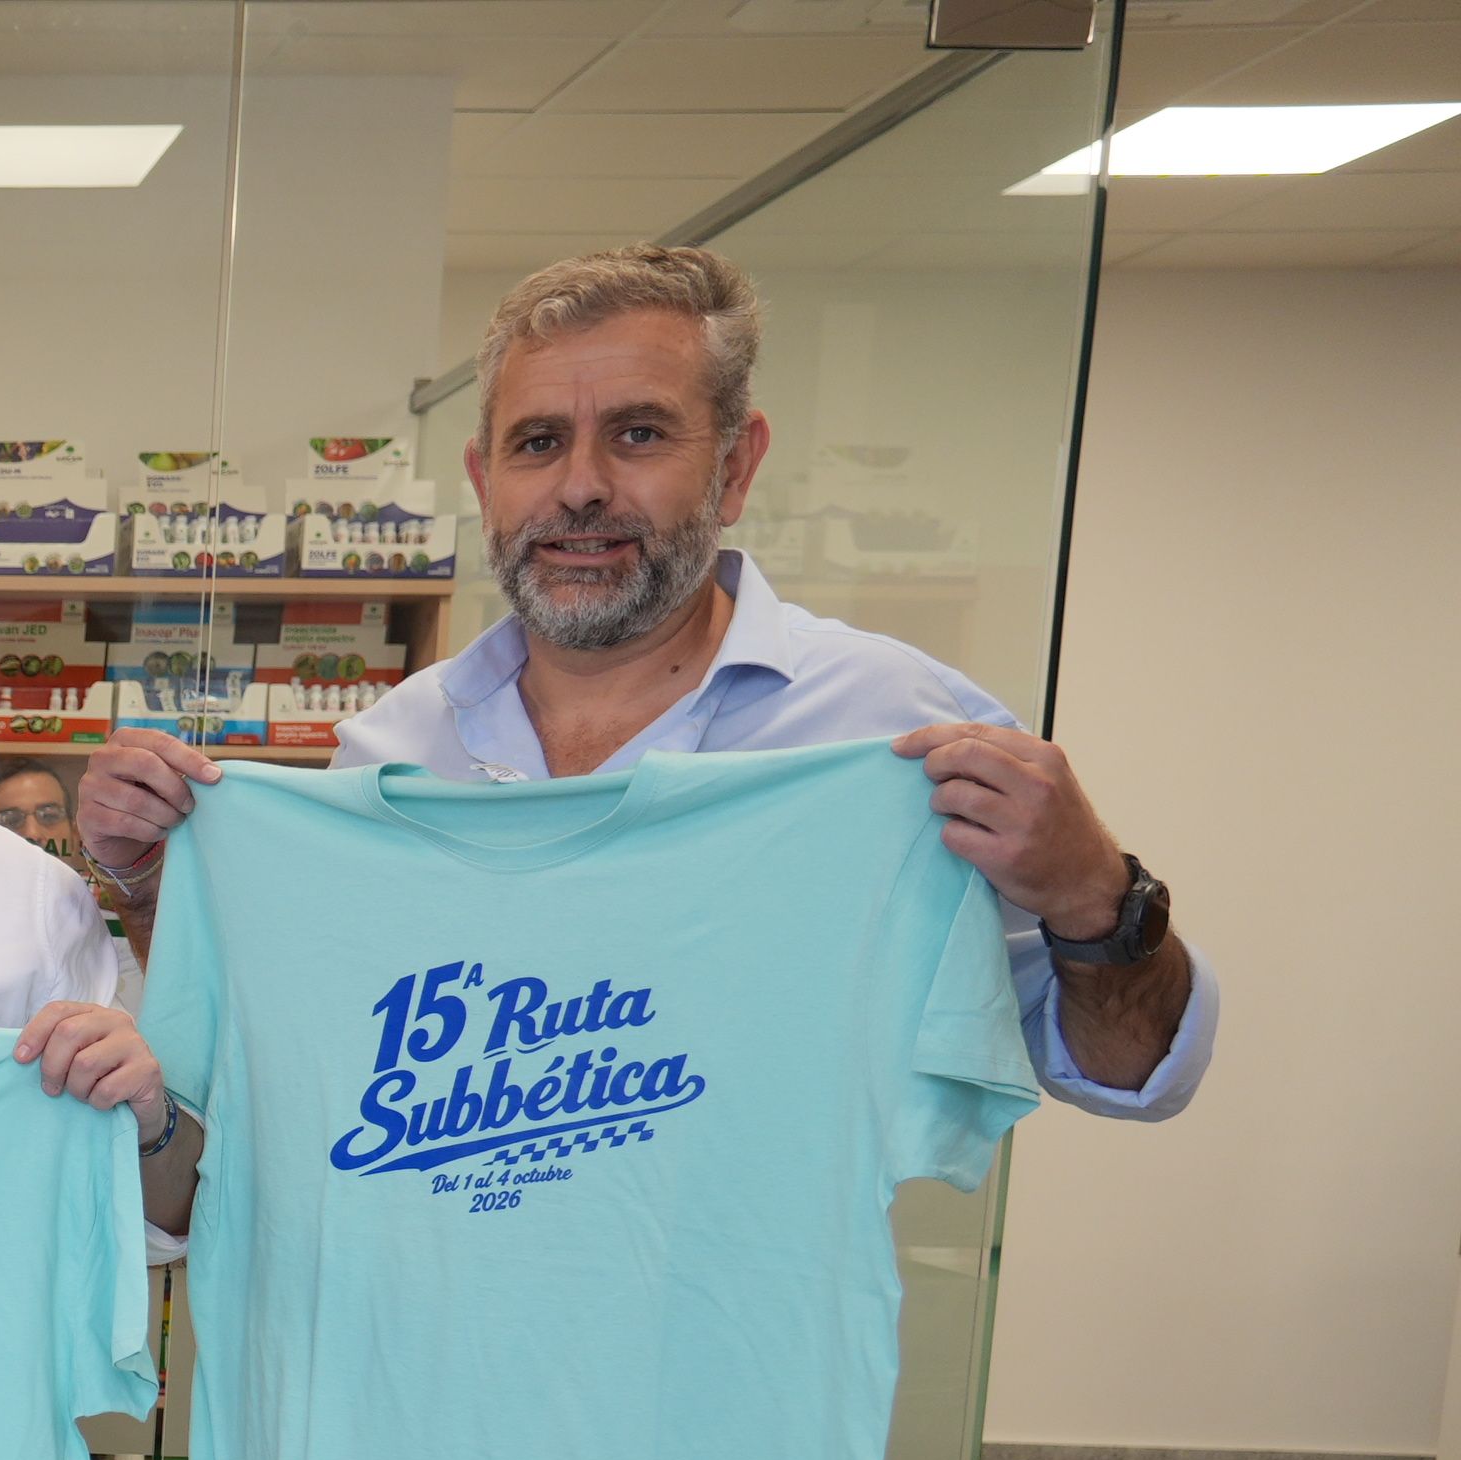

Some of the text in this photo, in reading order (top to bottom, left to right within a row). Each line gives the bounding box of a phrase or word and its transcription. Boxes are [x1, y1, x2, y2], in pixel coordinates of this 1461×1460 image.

[22, 625, 47, 636] JED
[483, 976, 656, 1054] Ruta
[330, 1046, 706, 1171] Subbética
[432, 1165, 573, 1194] Del 1 al 4 octubre
[469, 1190, 522, 1213] 2026
